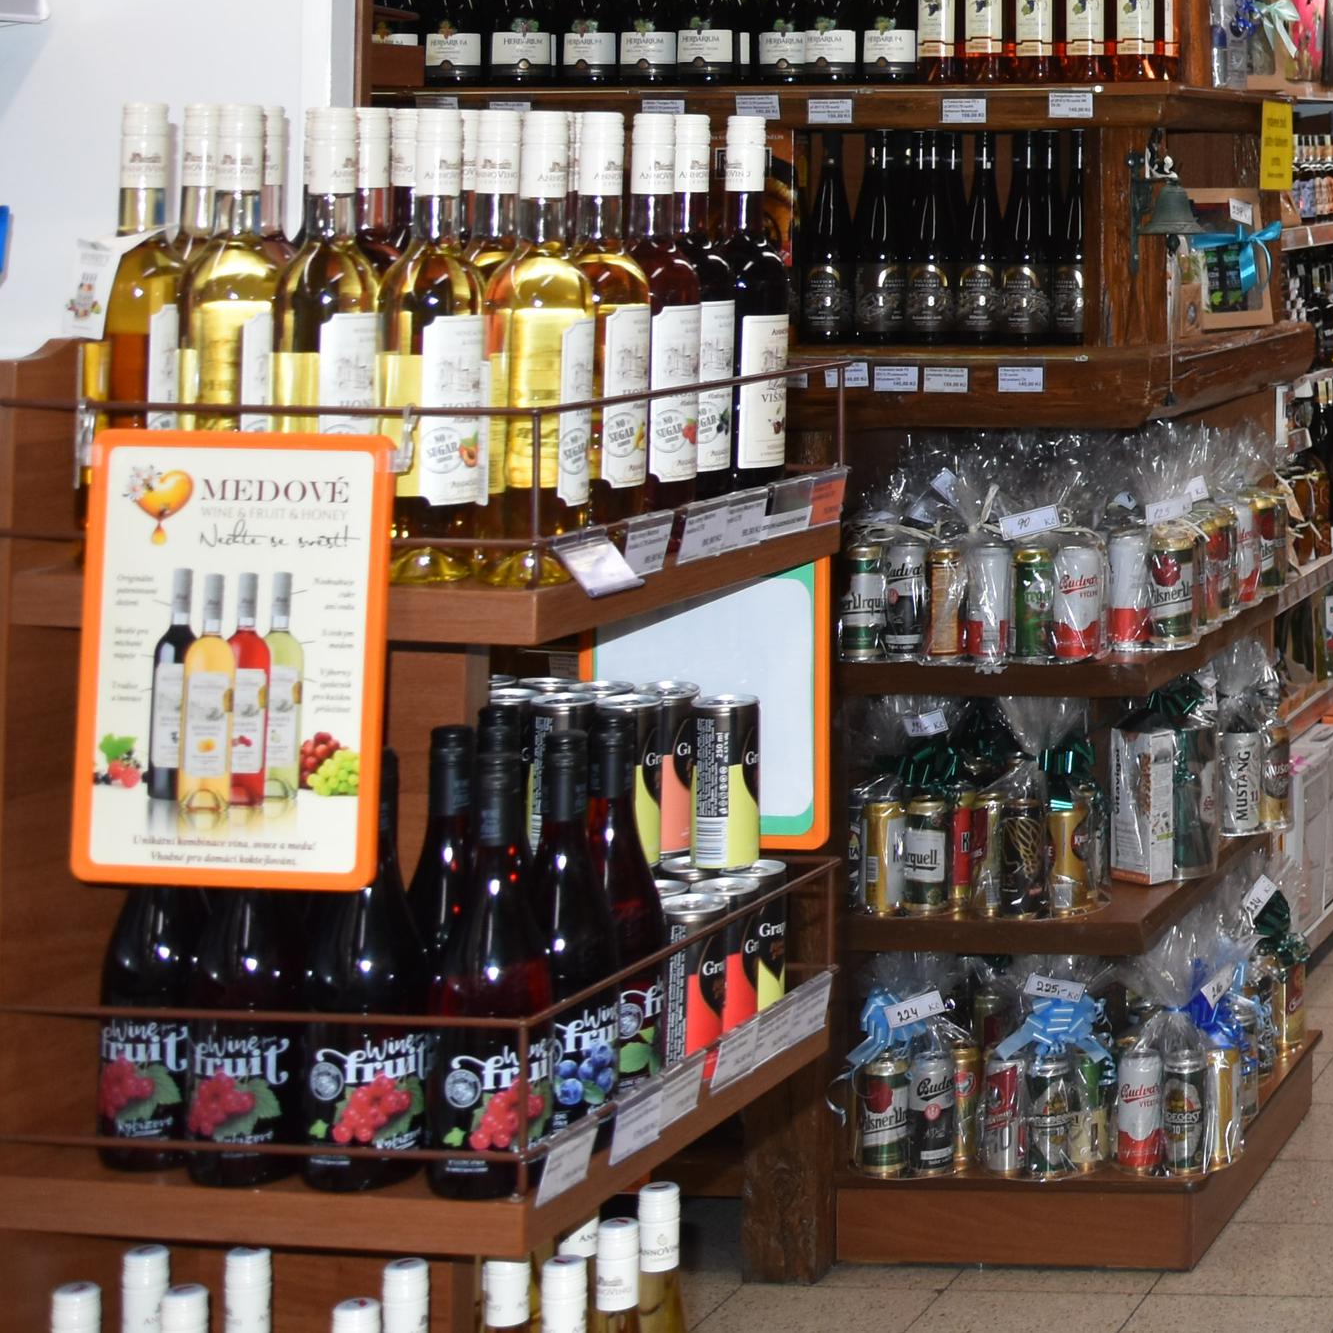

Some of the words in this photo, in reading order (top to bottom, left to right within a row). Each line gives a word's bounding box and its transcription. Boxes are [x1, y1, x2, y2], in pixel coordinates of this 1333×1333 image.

[201, 476, 349, 504] MEDOVÉ
[201, 506, 235, 517] WINE
[250, 507, 287, 519] FRUIT
[301, 509, 348, 521] HONEY
[199, 520, 268, 547] Nechte
[1236, 750, 1251, 820] MUSTANG
